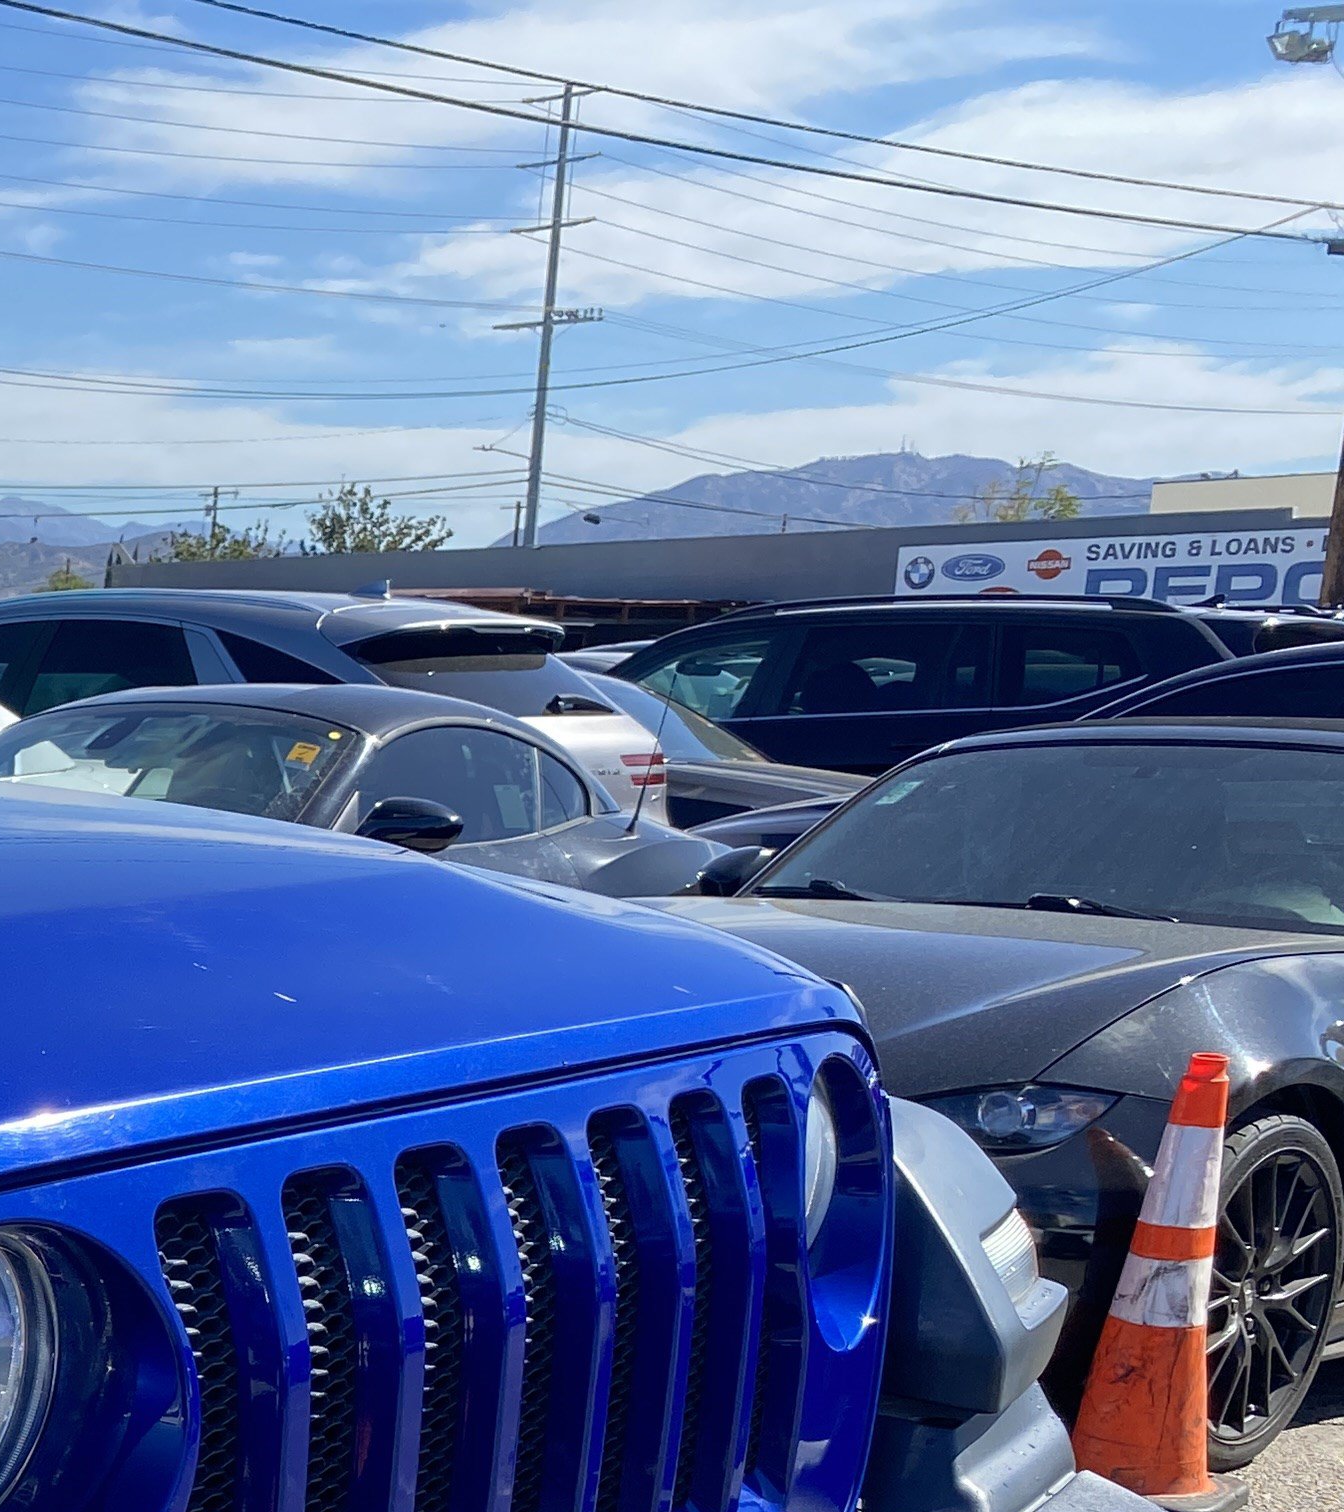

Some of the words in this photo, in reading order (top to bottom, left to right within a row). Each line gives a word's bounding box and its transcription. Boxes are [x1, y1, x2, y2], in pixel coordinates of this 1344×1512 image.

[1085, 541, 1177, 561] SAVING
[1188, 539, 1202, 557] &
[1210, 536, 1295, 557] LOANS
[954, 559, 992, 575] Ford
[1029, 560, 1069, 569] NISSAN
